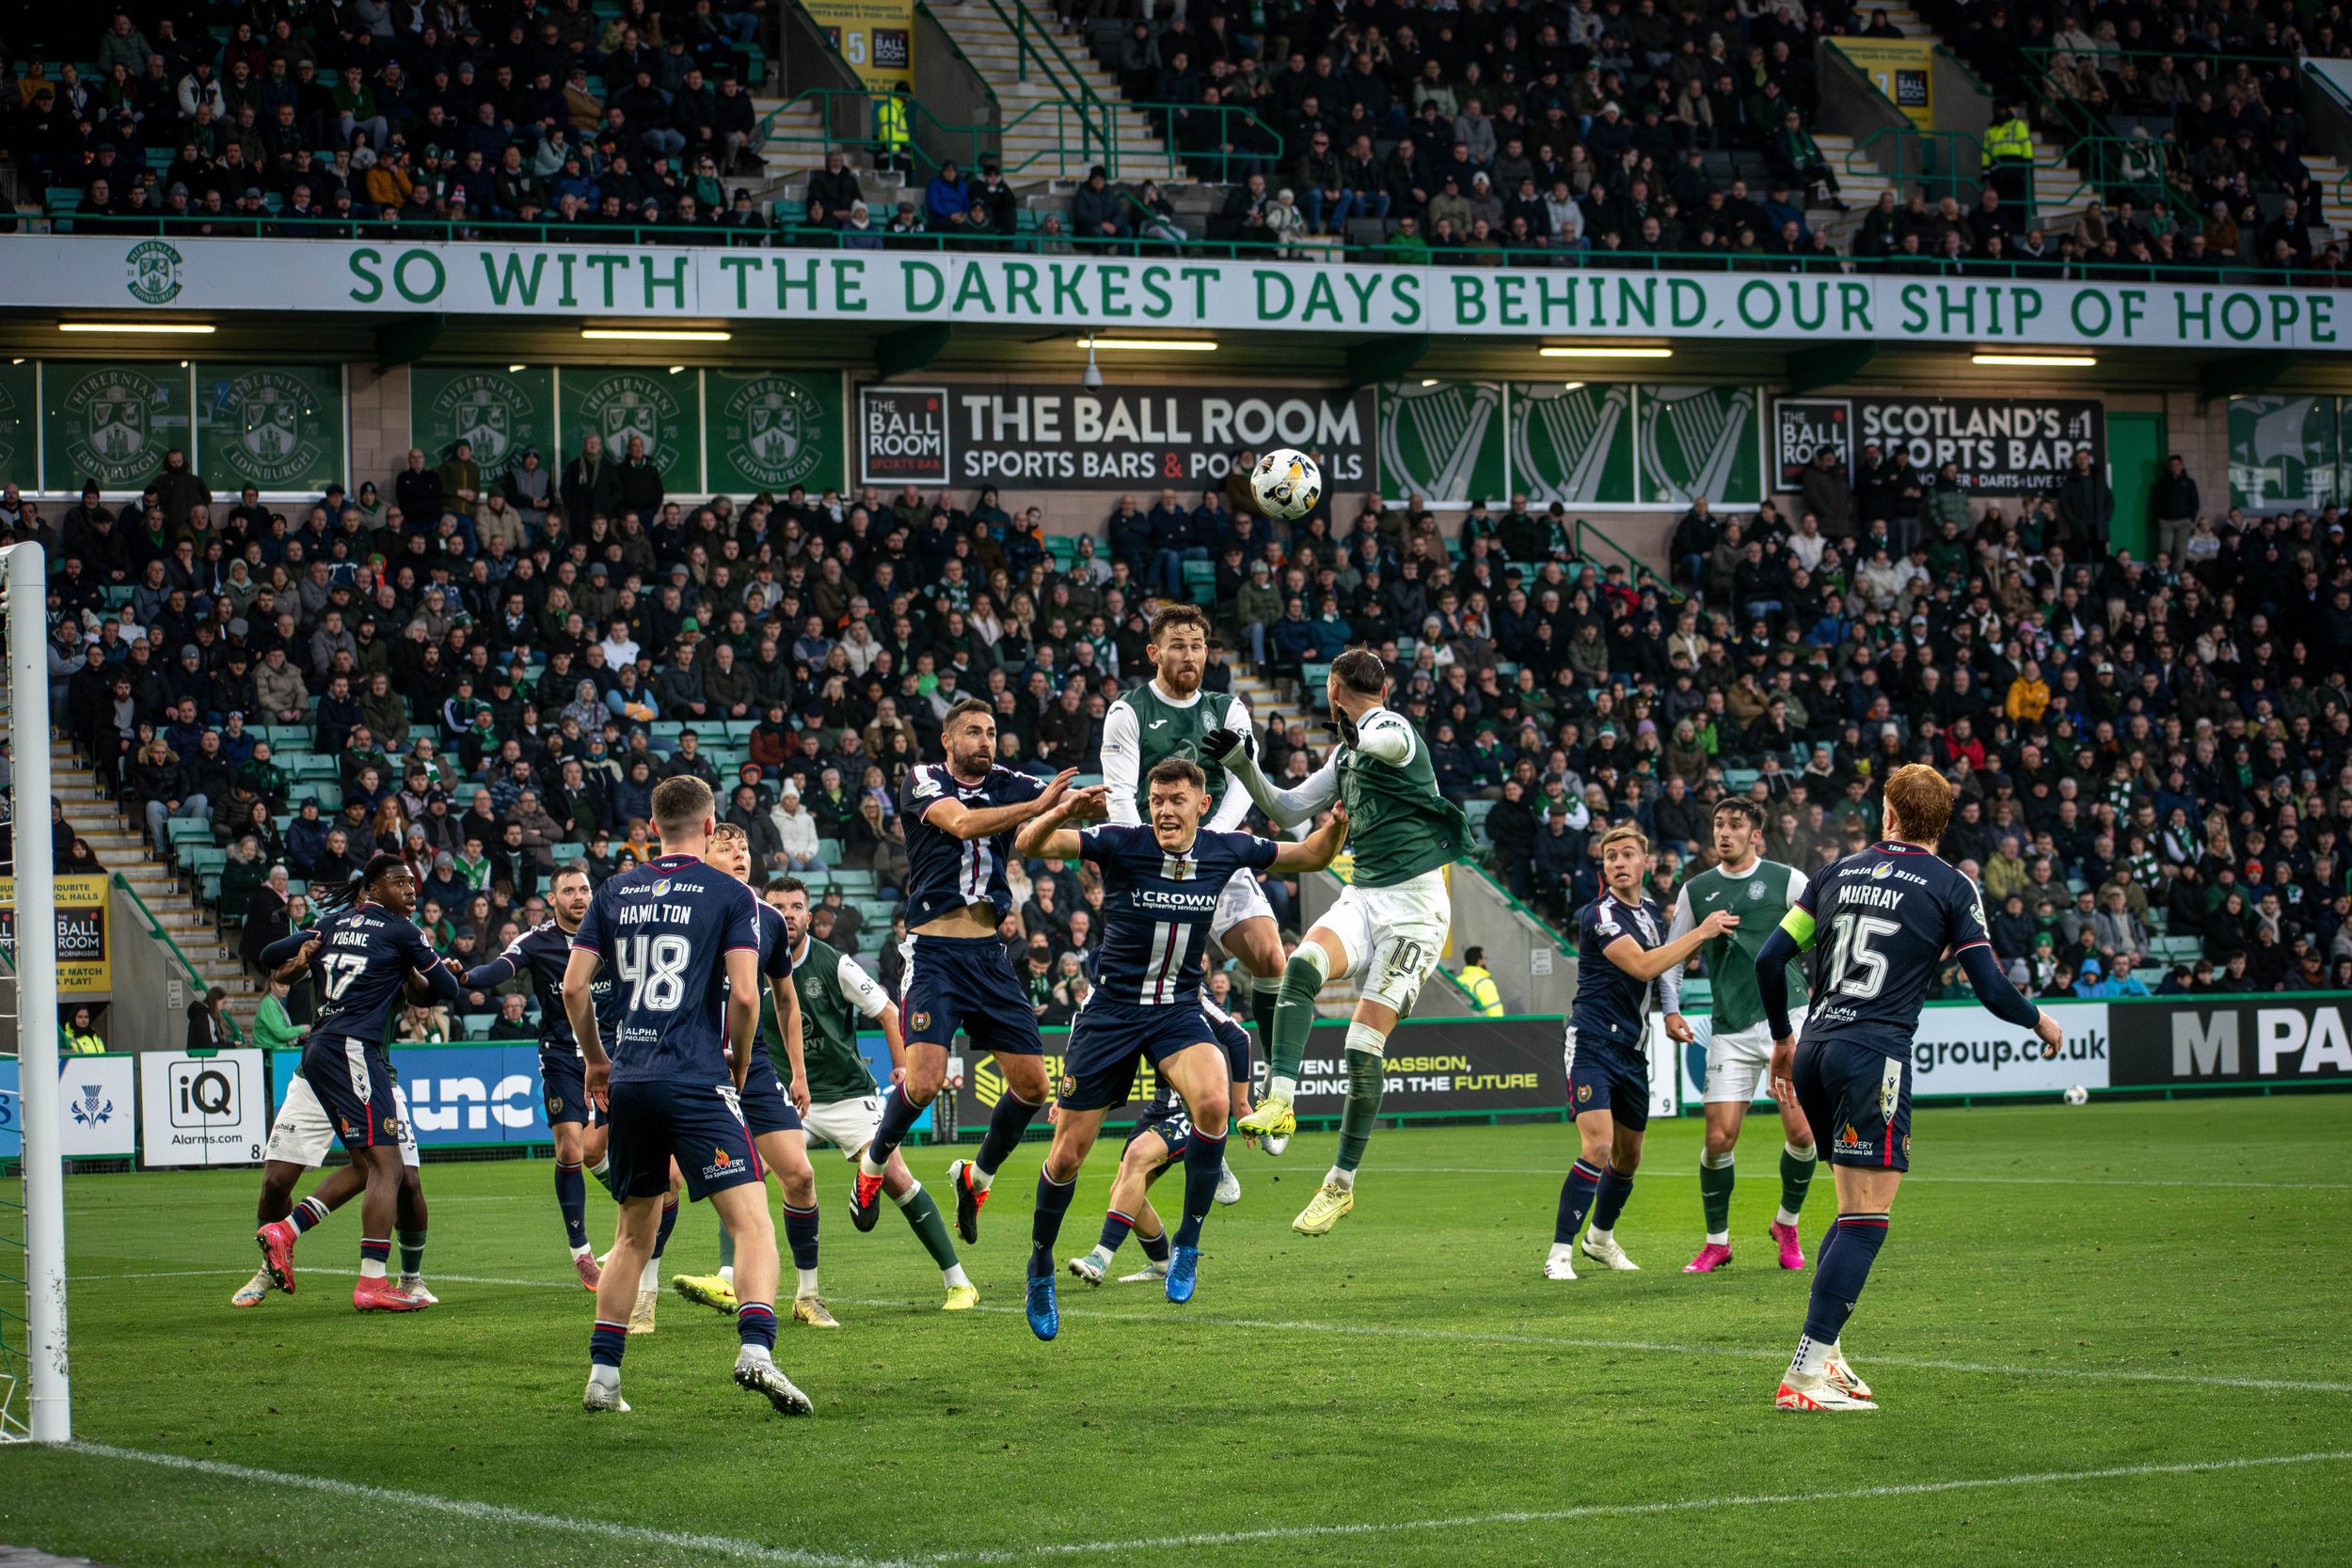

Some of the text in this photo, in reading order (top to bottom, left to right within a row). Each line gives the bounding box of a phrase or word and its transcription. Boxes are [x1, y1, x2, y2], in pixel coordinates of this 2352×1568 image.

[848, 32, 866, 64] 5
[875, 39, 905, 50] BALL
[349, 247, 2337, 342] SO WITH THE DARKEST DAYS BEHIND, OUR SHIP OF HOPE
[73, 372, 160, 406] HIBERNIAN
[440, 377, 525, 413] HIBERNIAN
[588, 377, 672, 414] HIBERNIAN
[870, 400, 896, 413] THE
[869, 412, 941, 436] BALL
[961, 395, 1361, 446] THE BALL ROOM
[1783, 411, 1805, 423] THE
[2067, 410, 2091, 439] #1
[1783, 424, 1846, 445] BALL
[869, 435, 941, 456] ROOM
[76, 450, 159, 481] EDINBURGH
[230, 450, 311, 481] EDINBURGH
[871, 457, 941, 471] SPORTS BAR
[964, 450, 1074, 479] SPORTS
[1083, 451, 1156, 479] BARS
[1164, 452, 1184, 479] &
[1979, 474, 2019, 487] DARTS
[2026, 475, 2053, 488] LIVE
[144, 850, 151, 862] K
[1838, 866, 1929, 886] Drain Blitz
[70, 893, 99, 901] HALLS
[167, 883, 174, 894] J
[620, 882, 706, 895] Drain Blitz
[1837, 884, 1904, 911] MURRAY
[1142, 891, 1217, 906] CROWN
[1142, 901, 1177, 911] engineering
[193, 914, 199, 926] H
[620, 903, 692, 925] HAMILTON
[58, 921, 100, 936] BALL
[58, 937, 100, 949] ROOM
[332, 931, 370, 947] YOGANE
[219, 947, 226, 958] G
[1390, 937, 1422, 974] 10
[1829, 912, 1902, 1001] 15
[69, 968, 103, 976] MATCH
[321, 952, 369, 1001] 17
[614, 933, 691, 1012] 48
[64, 977, 92, 986] PLAY!
[626, 1027, 658, 1037] ALPHA
[2171, 1006, 2352, 1077] M PA
[1915, 1029, 2106, 1074] group.co.uk
[1407, 1076, 1451, 1092] THE
[1455, 1073, 1538, 1090] FUTURE
[180, 1070, 231, 1117] iQ
[1662, 1099, 1671, 1113] 9
[171, 1132, 244, 1146] Alarms.com
[250, 1144, 261, 1160] 8
[1839, 1148, 1863, 1156] Sprinklers
[703, 1159, 745, 1176] DISCOVERY
